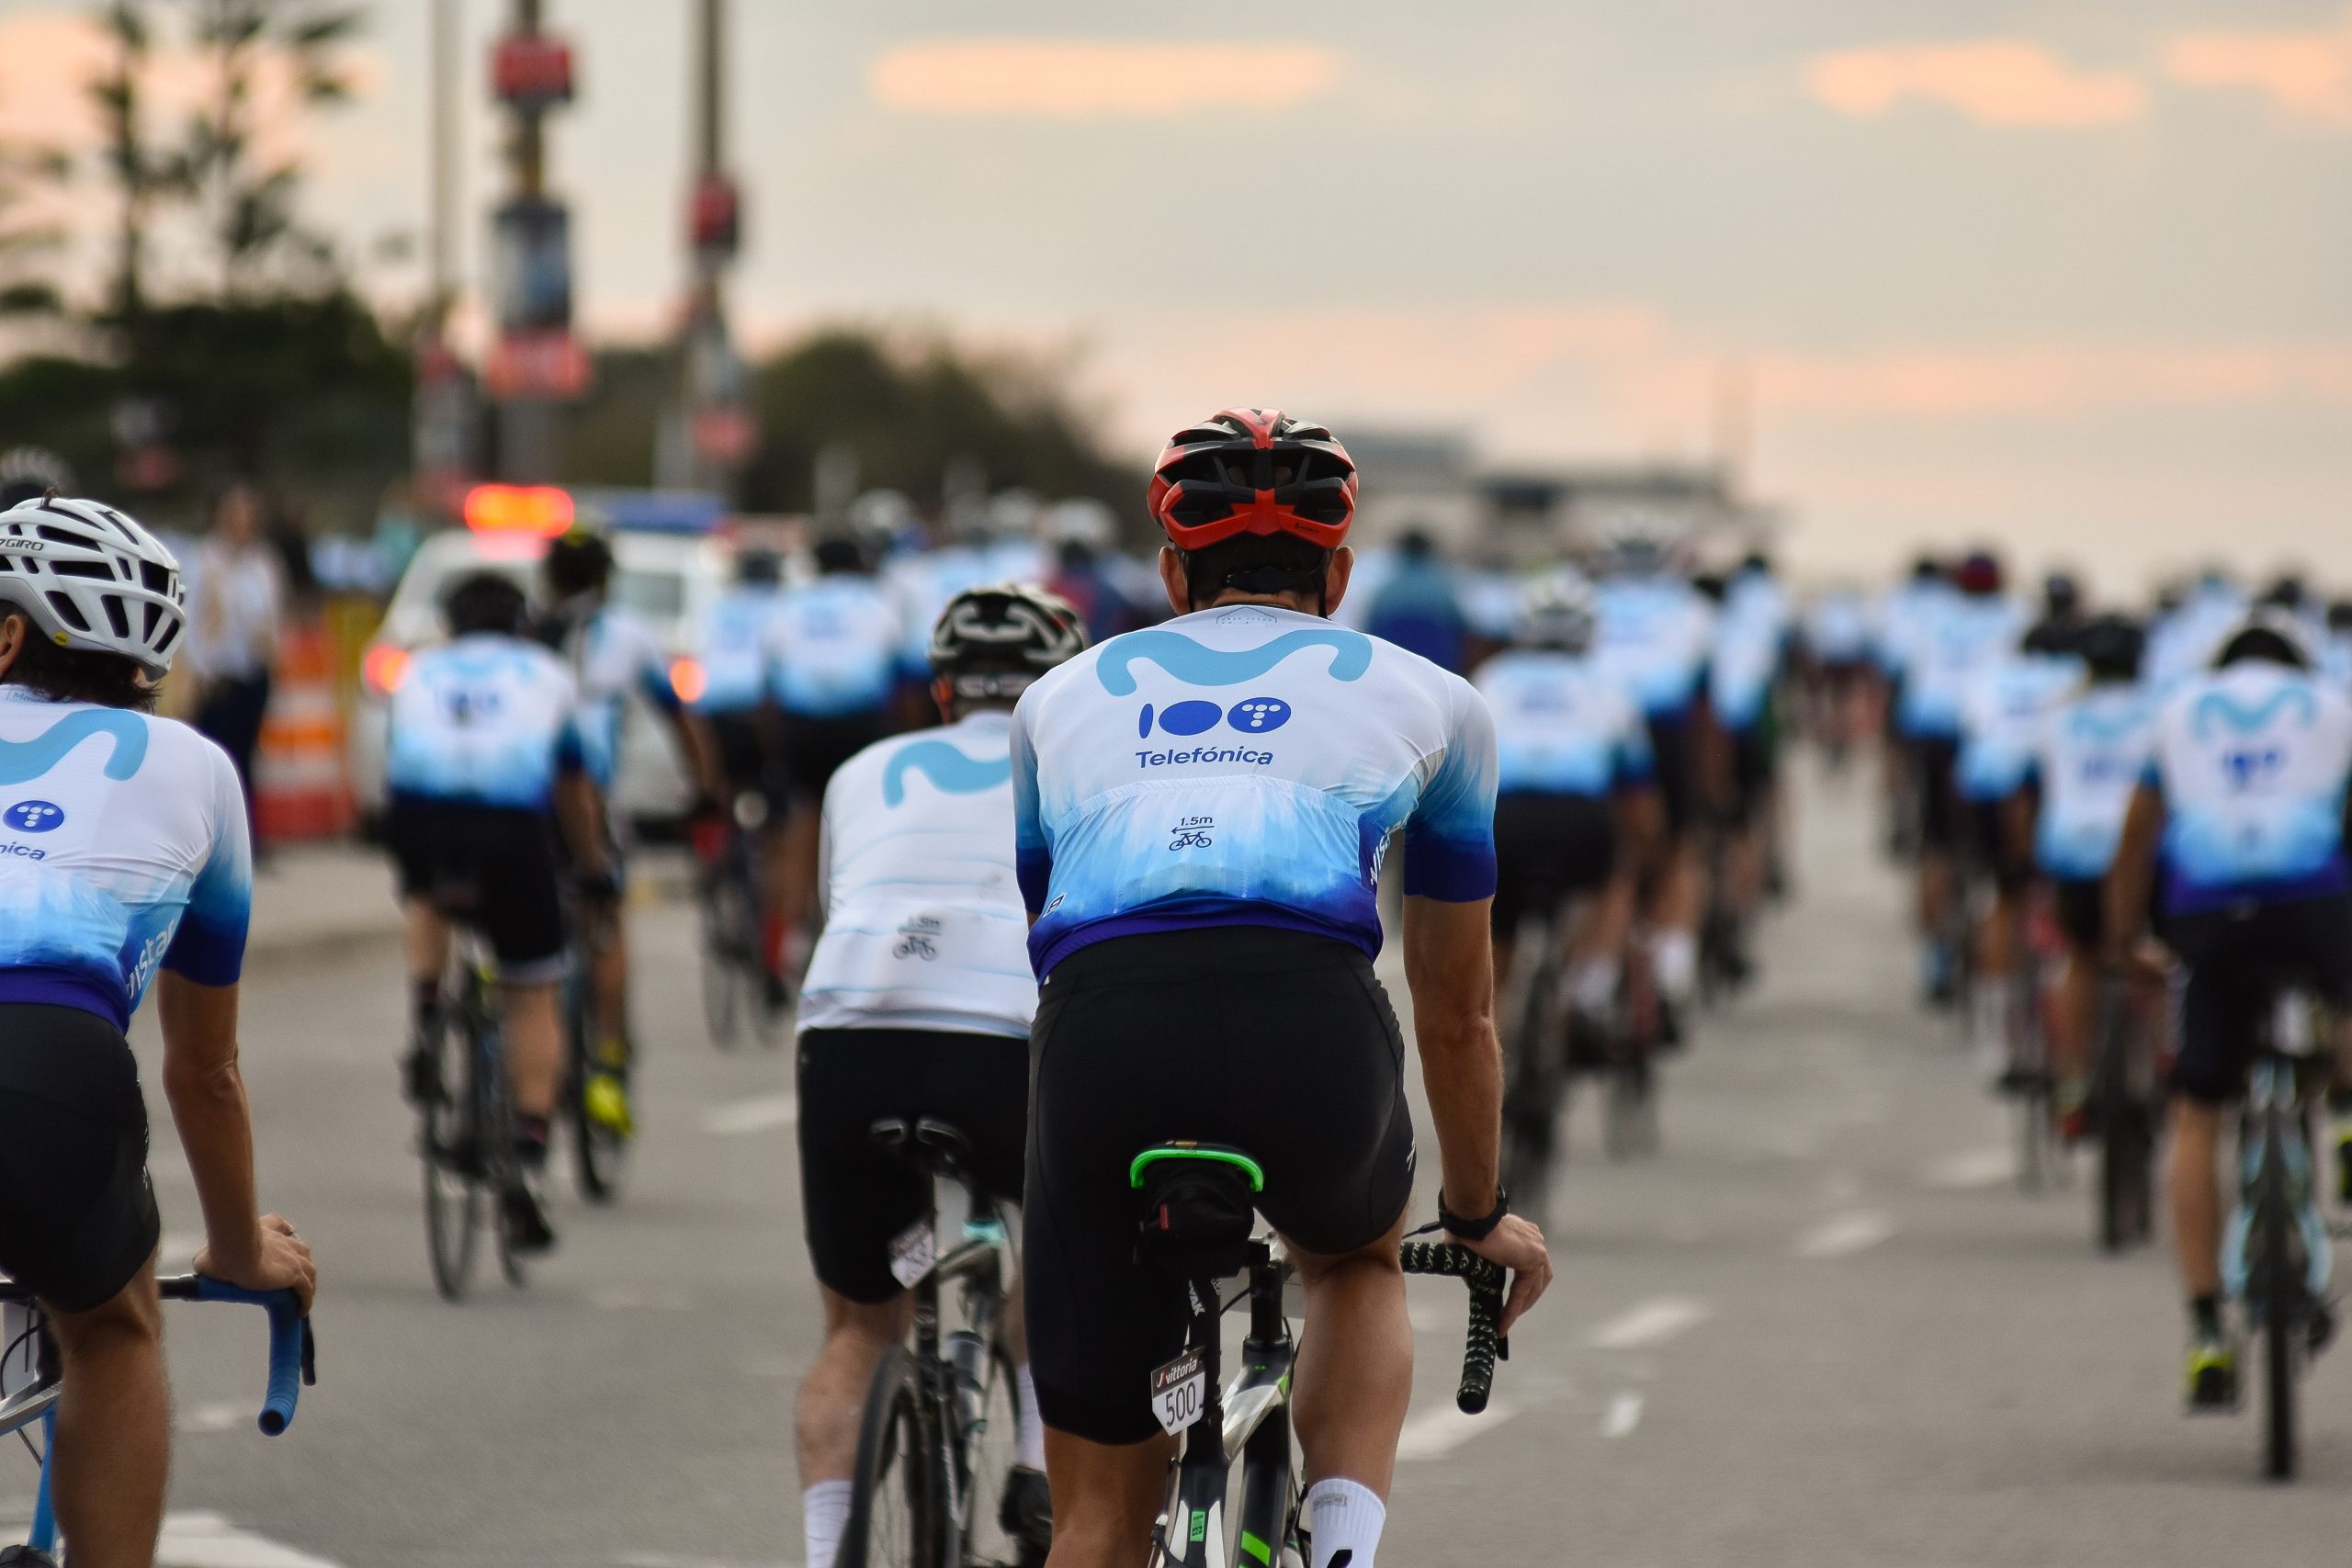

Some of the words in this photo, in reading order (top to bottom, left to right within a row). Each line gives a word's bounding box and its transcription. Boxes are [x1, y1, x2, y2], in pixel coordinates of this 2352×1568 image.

[6, 538, 44, 551] GIRO
[1136, 745, 1273, 769] Telefónica
[1181, 817, 1213, 827] 1.5m
[1165, 1358, 1198, 1384] vittoria
[1165, 1382, 1196, 1428] 500
